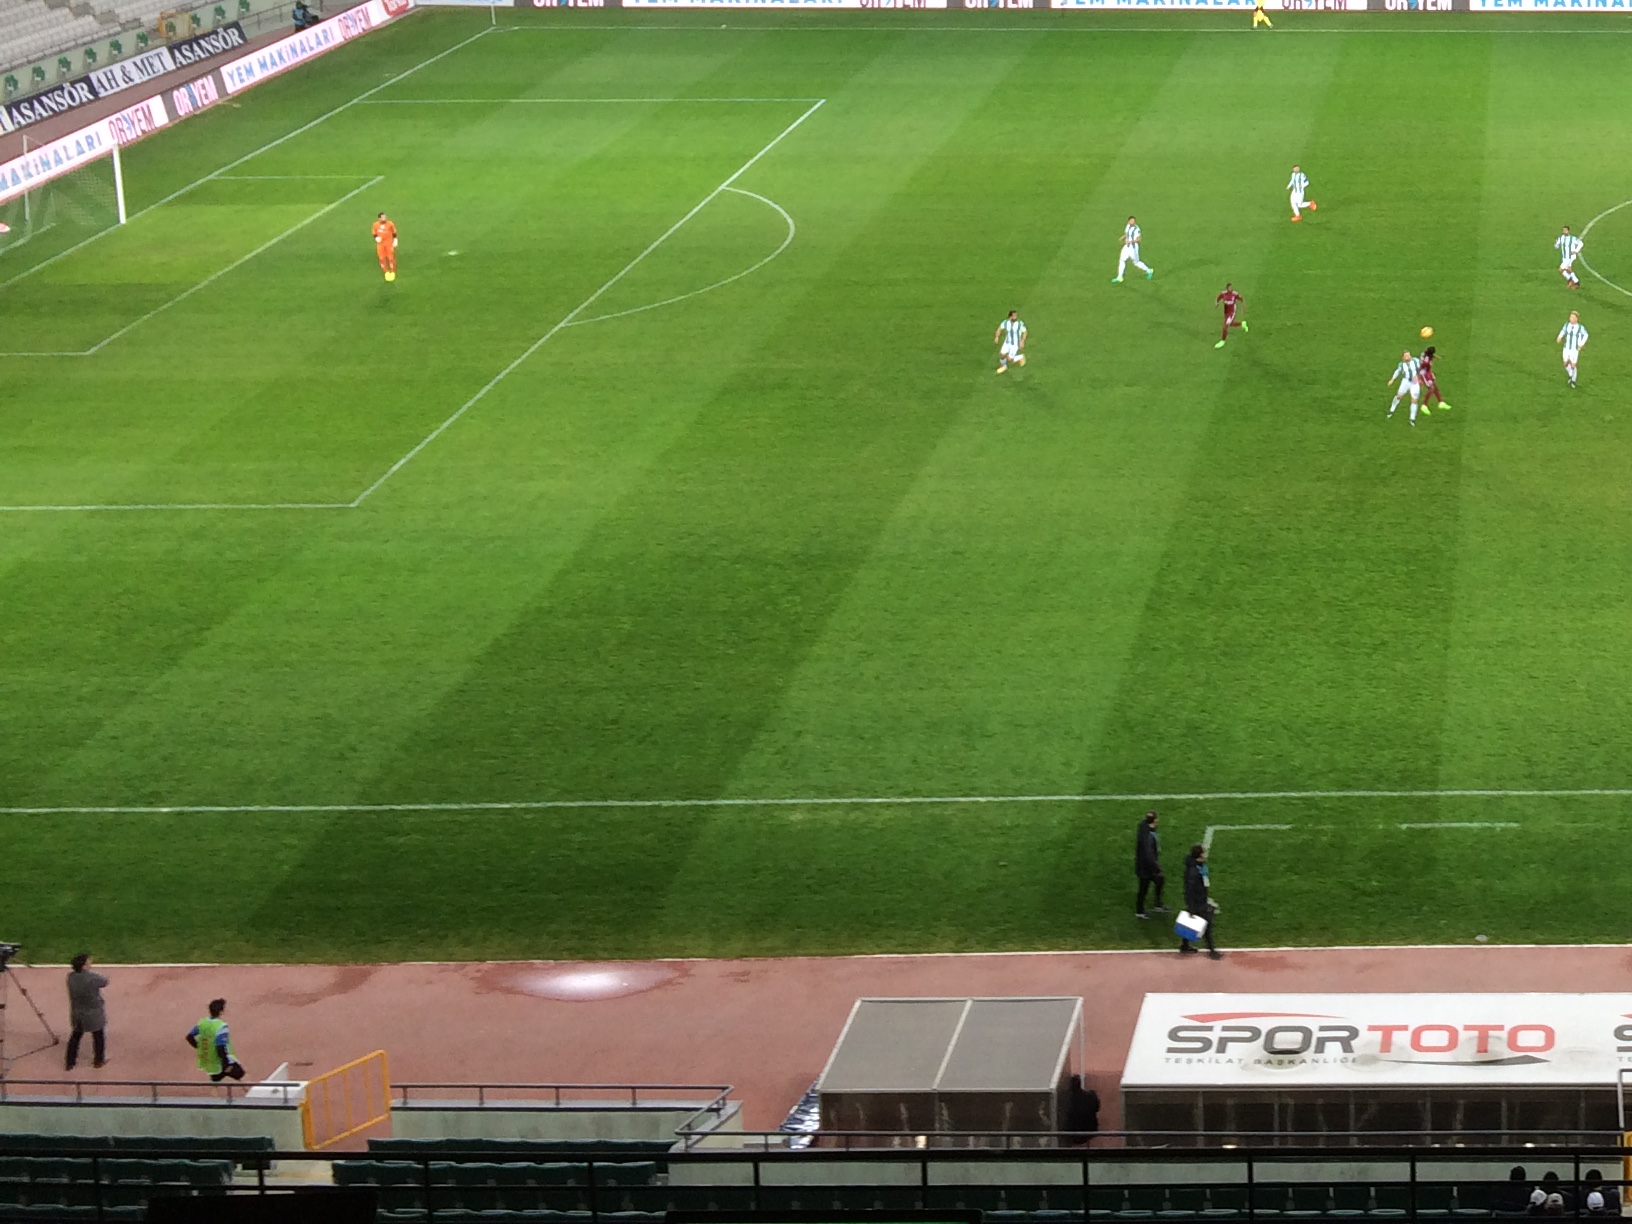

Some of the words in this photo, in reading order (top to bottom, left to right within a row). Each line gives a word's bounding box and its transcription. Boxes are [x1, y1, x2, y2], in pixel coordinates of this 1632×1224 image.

[174, 27, 244, 67] ASANSÖR
[226, 62, 254, 87] YEM
[10, 82, 95, 128] ASANSÖR
